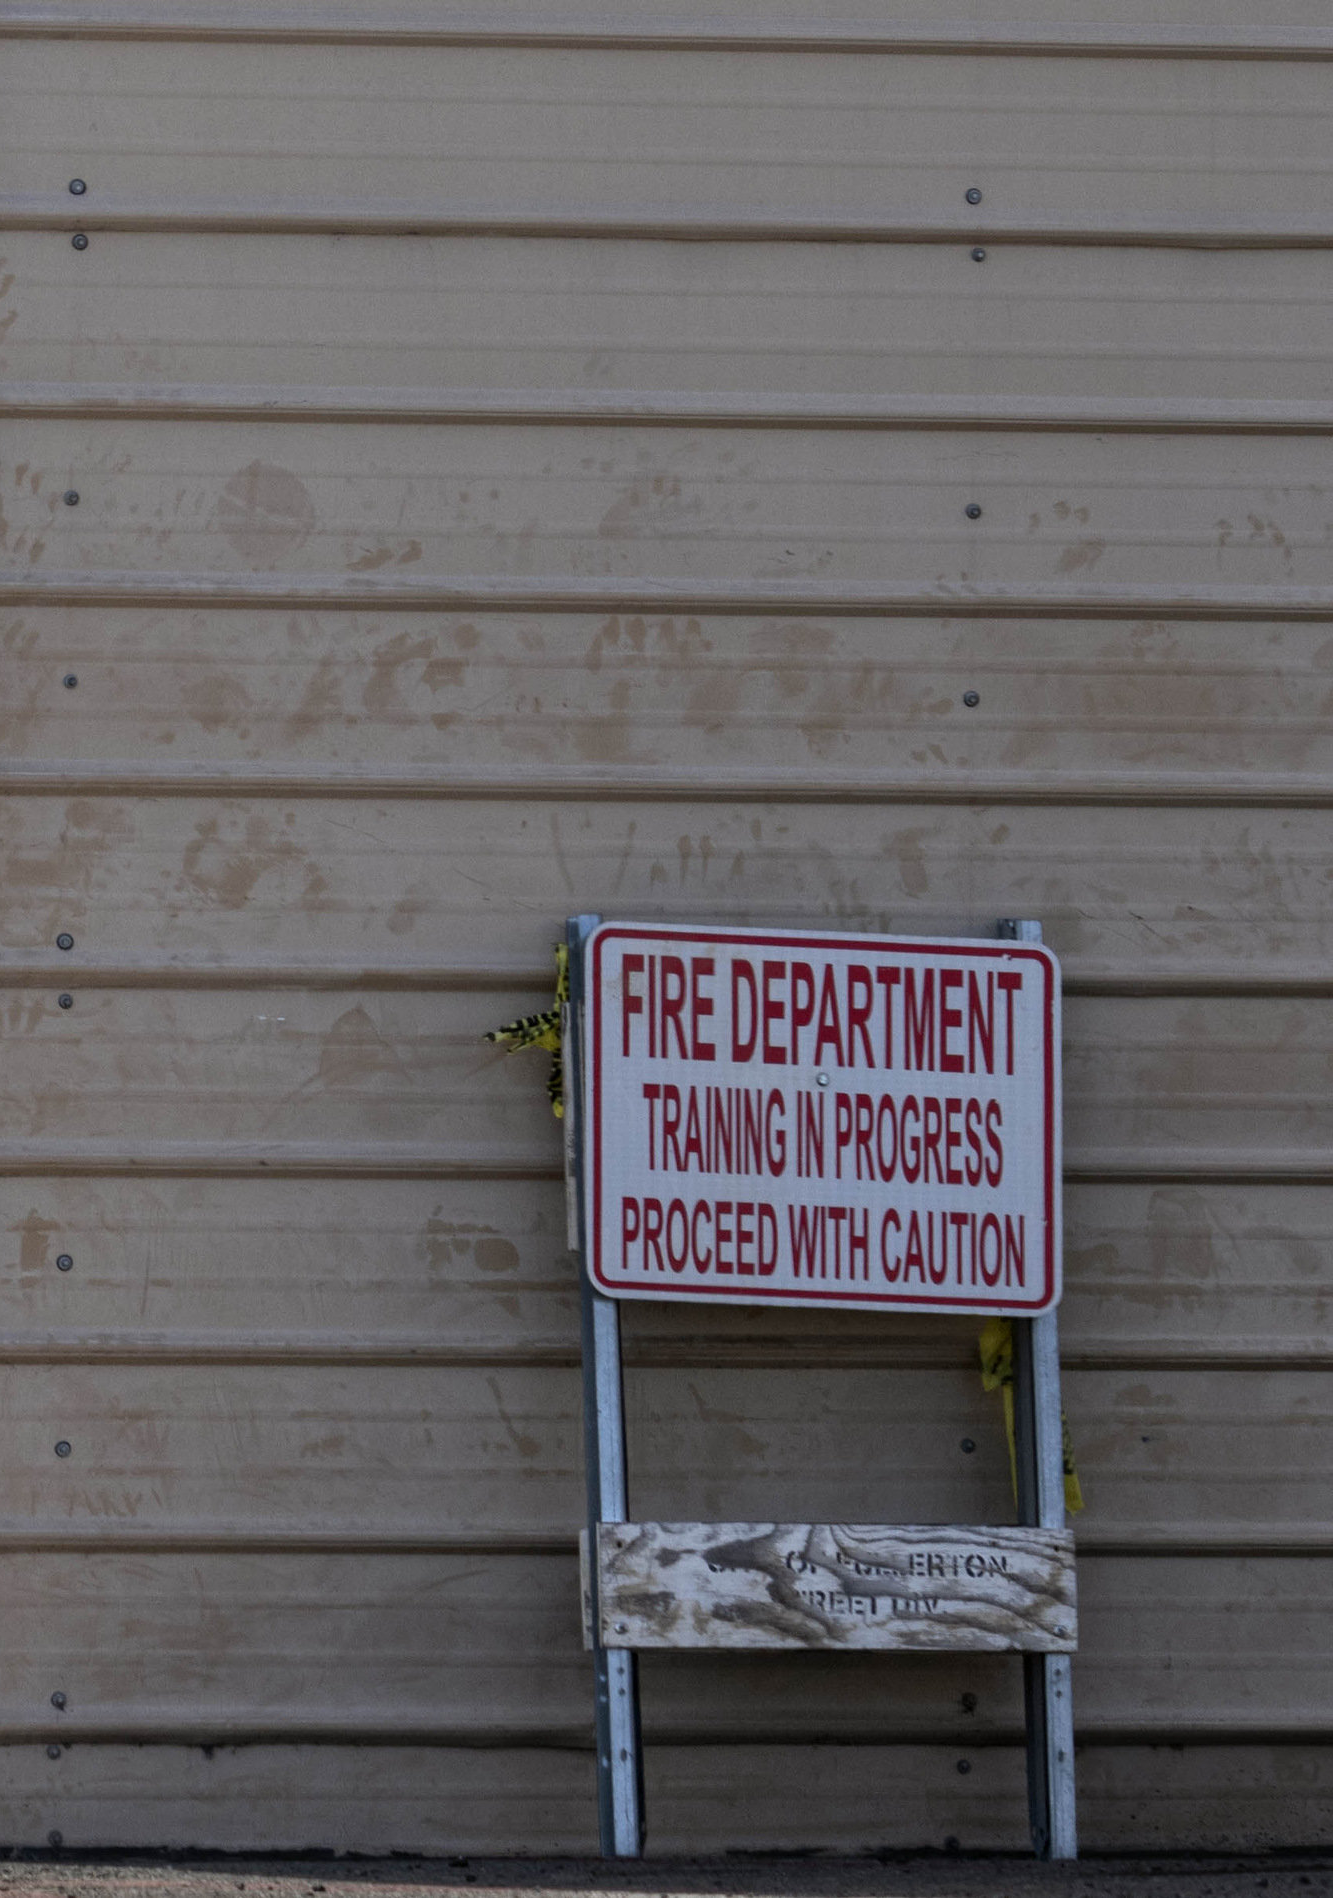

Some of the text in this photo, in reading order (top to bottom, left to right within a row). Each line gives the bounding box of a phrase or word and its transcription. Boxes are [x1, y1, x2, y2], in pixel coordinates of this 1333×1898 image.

[622, 954, 1023, 1076] FIRE DEPARTMENT
[643, 1084, 786, 1177] TRAINING
[797, 1091, 824, 1178] IN
[836, 1092, 1003, 1188] PROGRESS
[621, 1196, 1025, 1288] PROCEED WITH CAUTION
